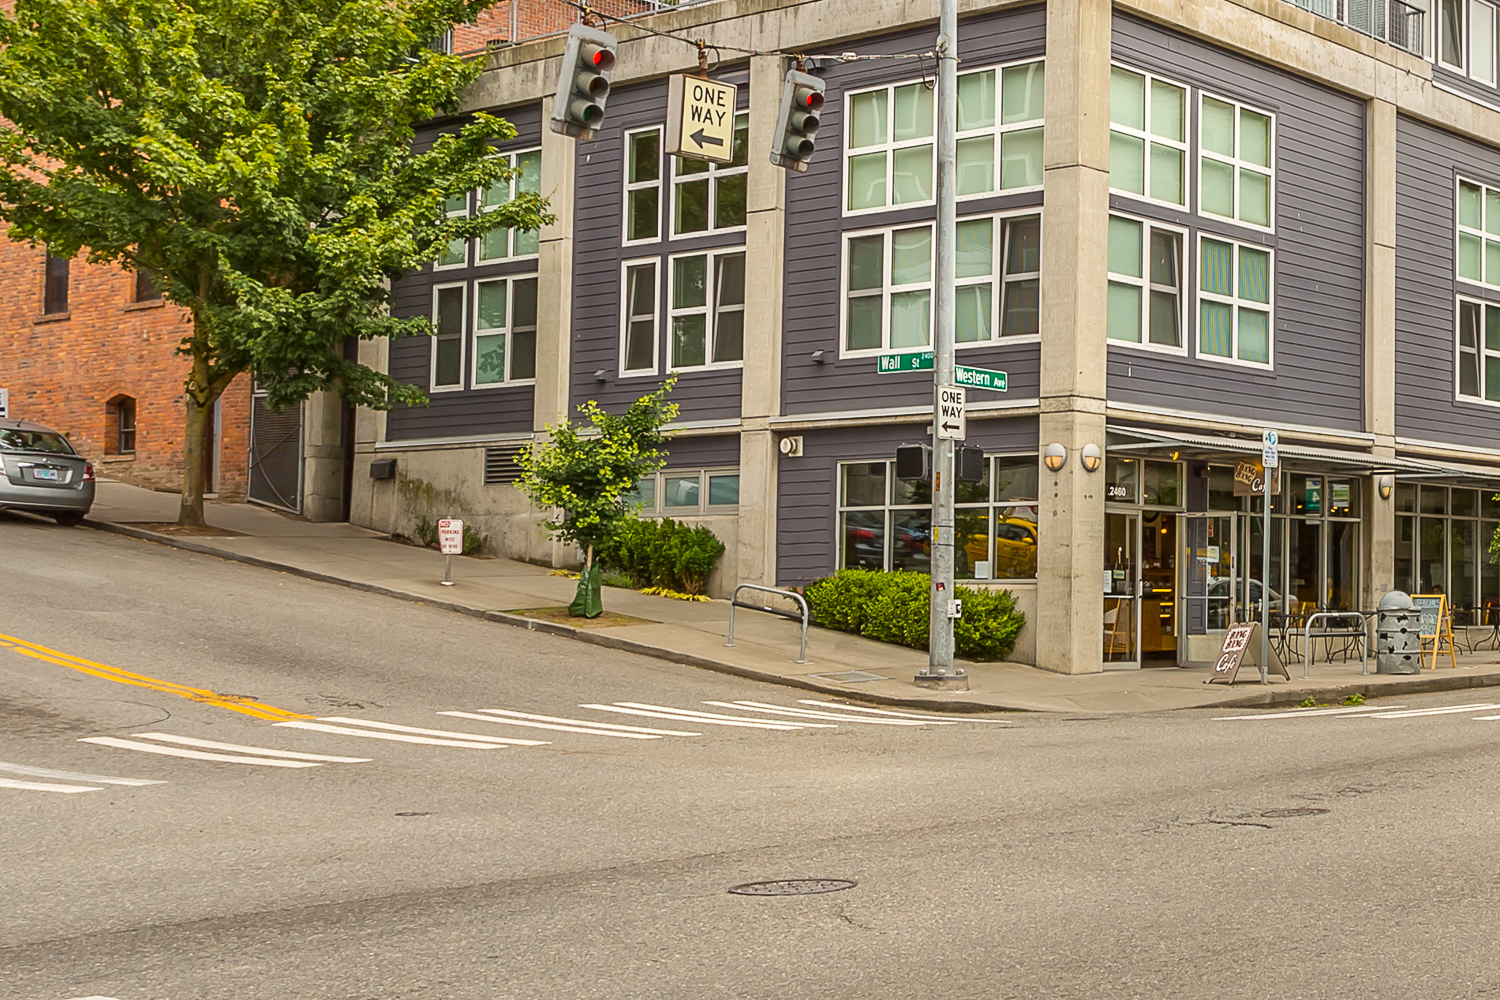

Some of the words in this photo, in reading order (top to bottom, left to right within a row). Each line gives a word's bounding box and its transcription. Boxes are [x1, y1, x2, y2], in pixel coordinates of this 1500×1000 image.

[693, 85, 726, 107] ONE
[691, 104, 726, 127] WAY
[921, 352, 934, 360] 2400
[881, 356, 900, 370] Wall
[911, 358, 920, 368] St
[956, 367, 990, 386] Western
[993, 377, 1005, 388] Ave
[941, 391, 962, 404] ONE
[941, 405, 963, 418] WAY
[1109, 486, 1127, 497] 2460
